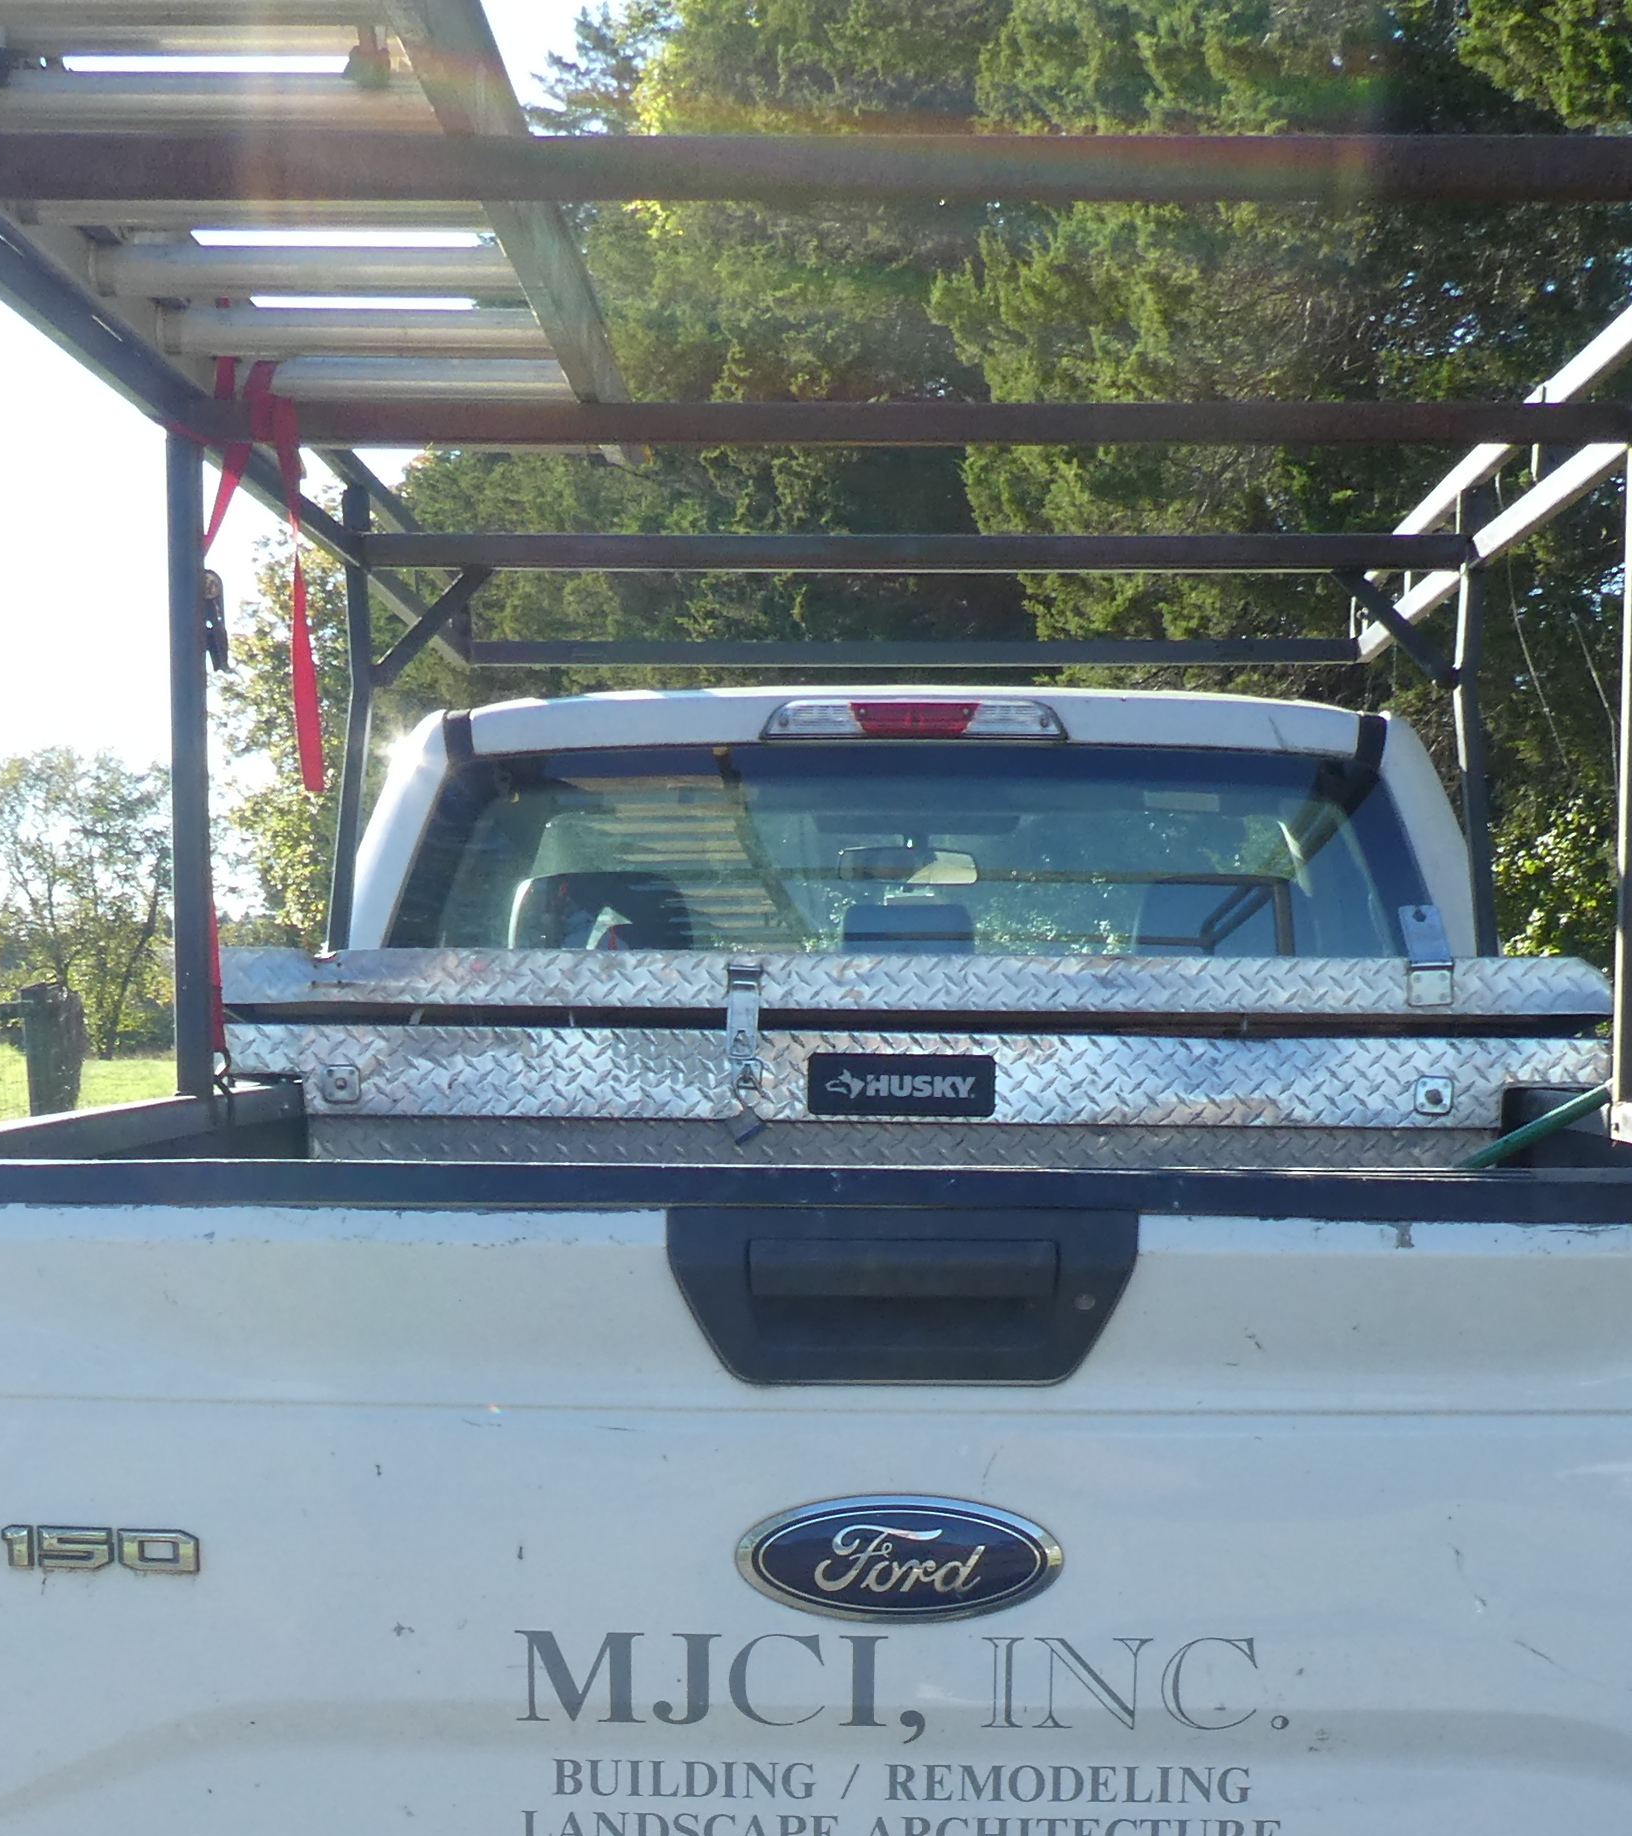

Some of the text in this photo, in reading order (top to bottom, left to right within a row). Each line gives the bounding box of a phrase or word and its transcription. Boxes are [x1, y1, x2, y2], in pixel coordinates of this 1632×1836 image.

[866, 1074, 975, 1099] HUSKY
[814, 1523, 985, 1600] Ford
[513, 1629, 1291, 1745] MJCI, INC.
[552, 1758, 1253, 1804] BUILDING / REMODELING
